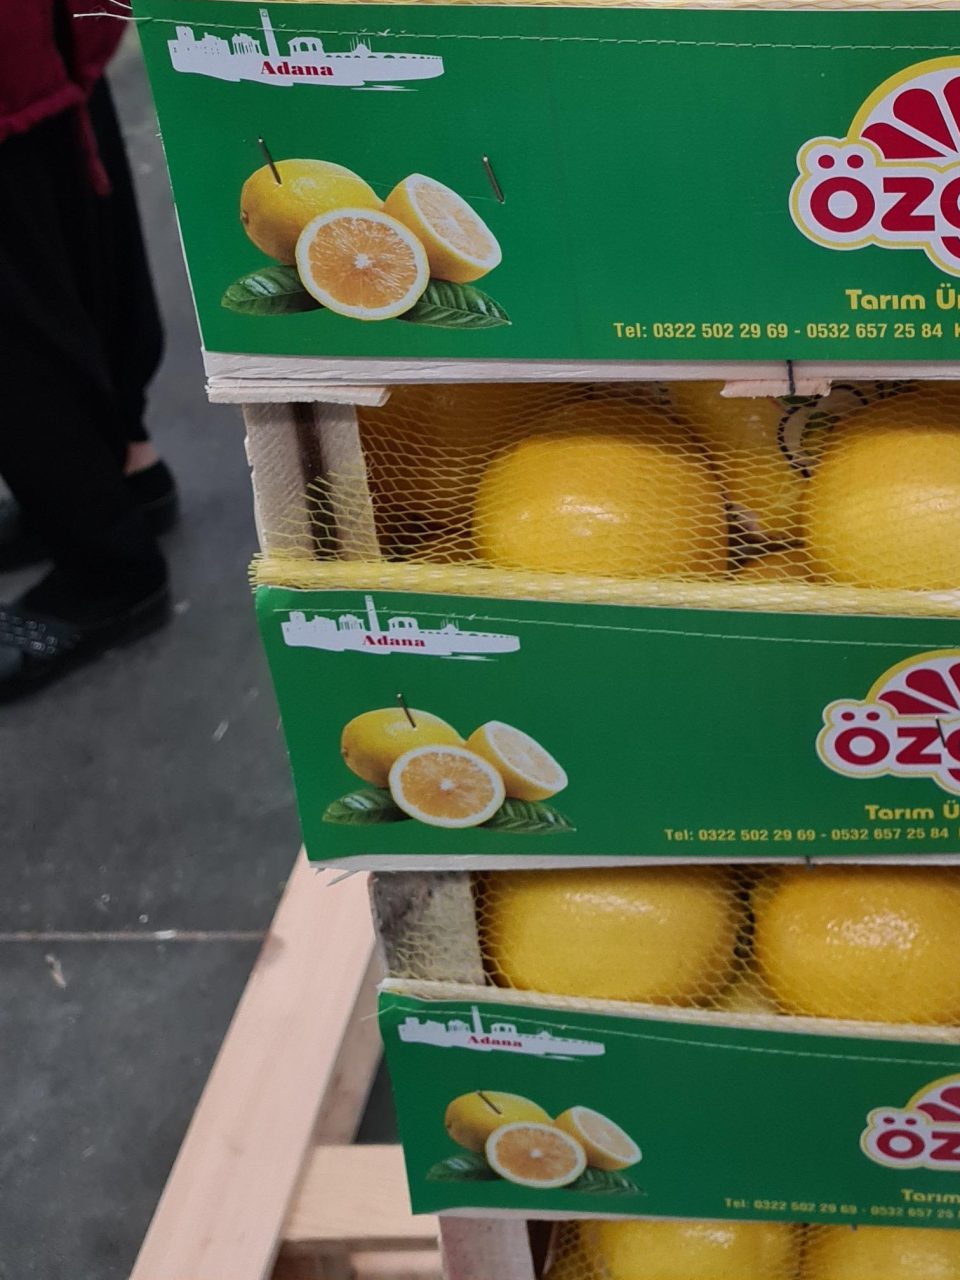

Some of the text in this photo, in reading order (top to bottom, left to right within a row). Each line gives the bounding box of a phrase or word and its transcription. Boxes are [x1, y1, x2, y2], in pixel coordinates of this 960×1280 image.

[261, 60, 334, 77] Adana
[845, 289, 926, 310] Tarım
[613, 323, 647, 338] Tel:
[653, 323, 696, 338] 0322
[702, 323, 734, 338] 502
[740, 323, 761, 338] 29
[766, 323, 788, 338] 69
[806, 323, 850, 338] 0532
[855, 323, 888, 338] 657
[894, 323, 915, 338] 25
[921, 323, 943, 338] 84
[362, 634, 426, 648] Adana
[865, 804, 935, 820] Tarım
[698, 829, 736, 841] 0322
[741, 829, 769, 841] 502
[774, 829, 793, 841] 29
[797, 829, 816, 841] 69
[831, 829, 869, 840] 0532
[874, 828, 901, 840] 657
[906, 828, 926, 839] 25
[930, 827, 949, 839] 84
[467, 1035, 523, 1048] Adana
